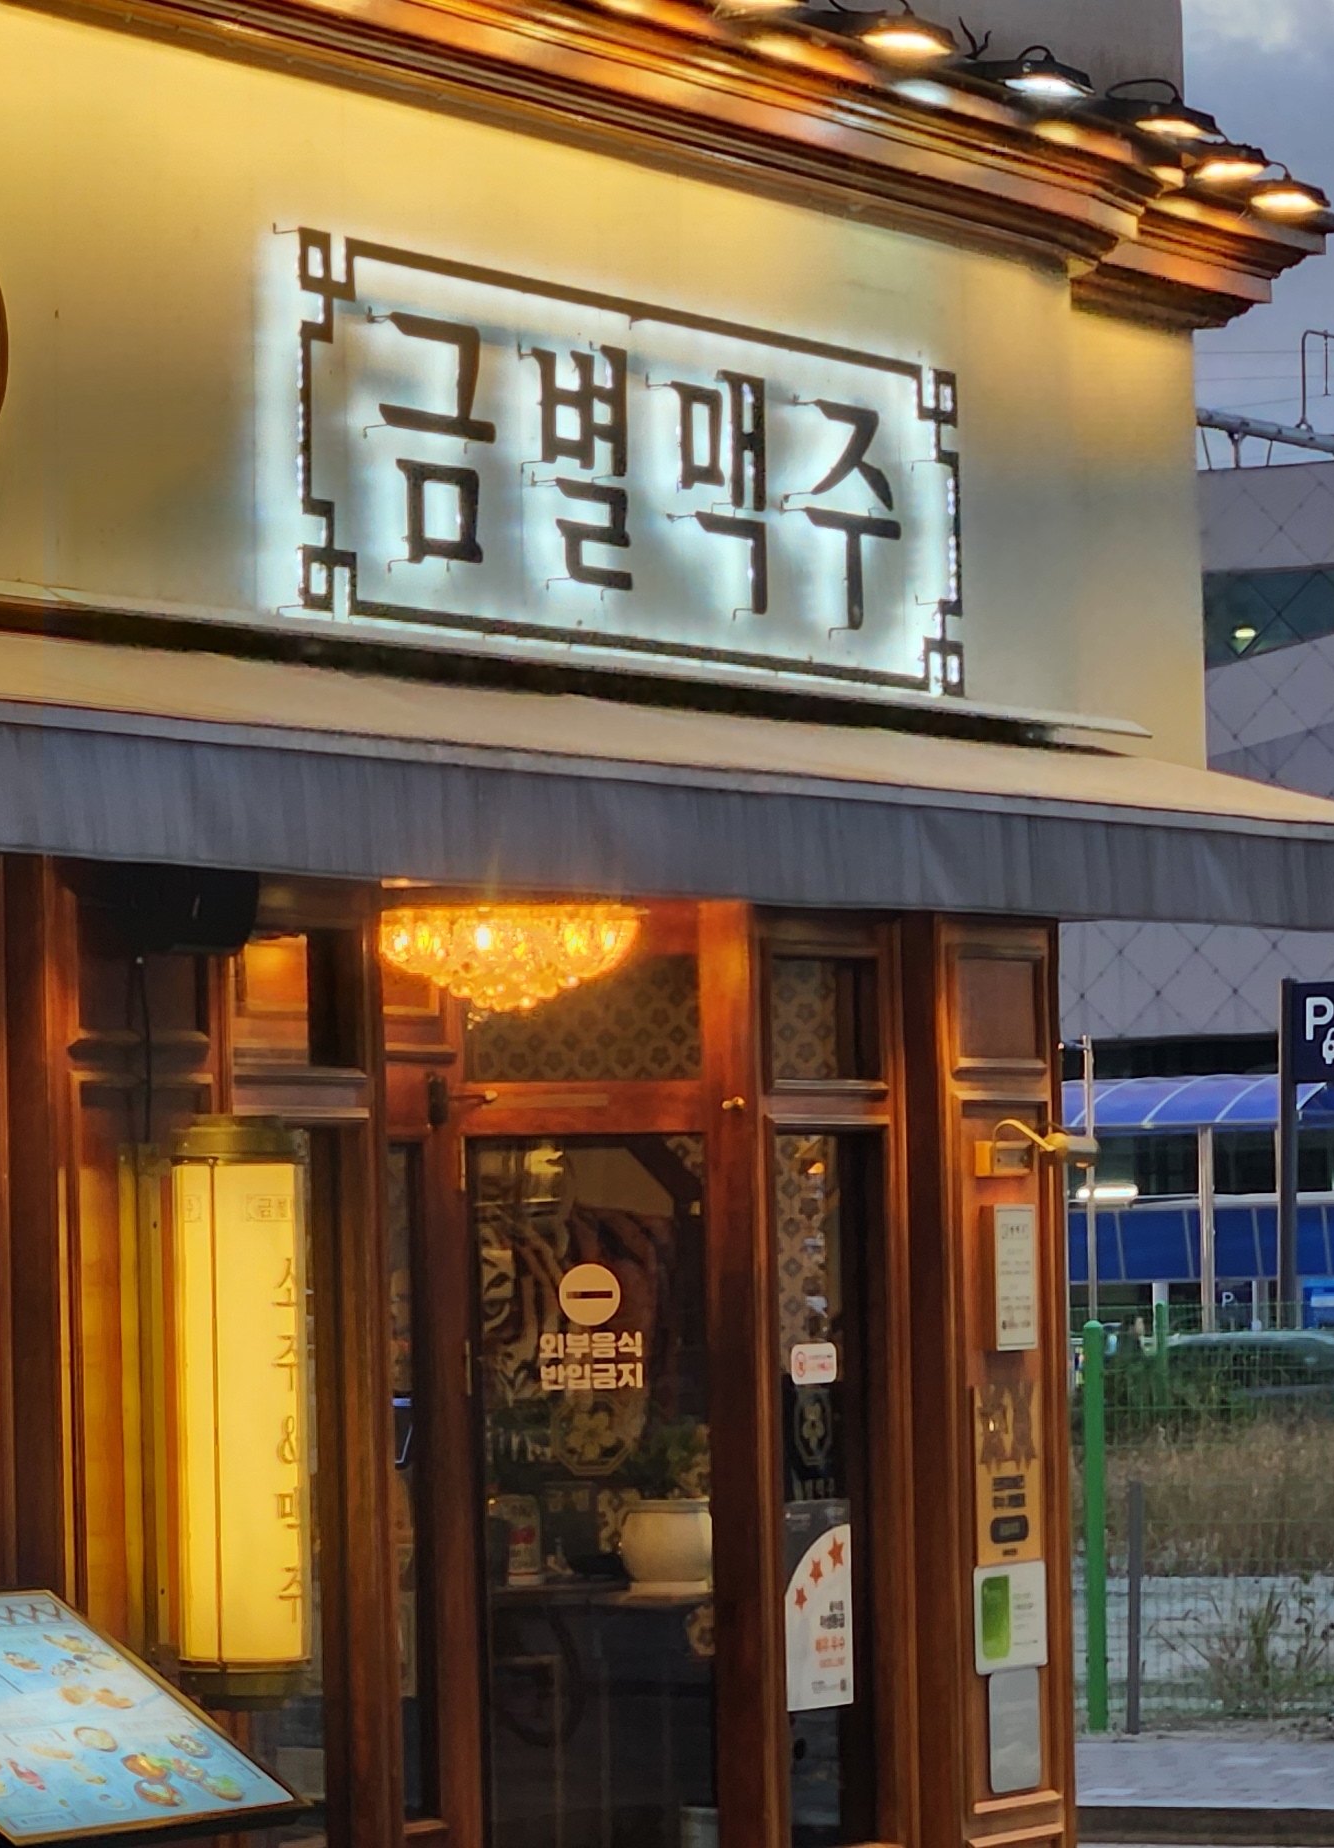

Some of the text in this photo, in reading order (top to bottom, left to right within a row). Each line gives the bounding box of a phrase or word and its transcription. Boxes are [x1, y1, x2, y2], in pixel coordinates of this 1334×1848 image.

[379, 311, 902, 631] 금별맥주
[1305, 996, 1334, 1041] P
[539, 1331, 643, 1359] 외부음식
[540, 1362, 644, 1390] 반입금지
